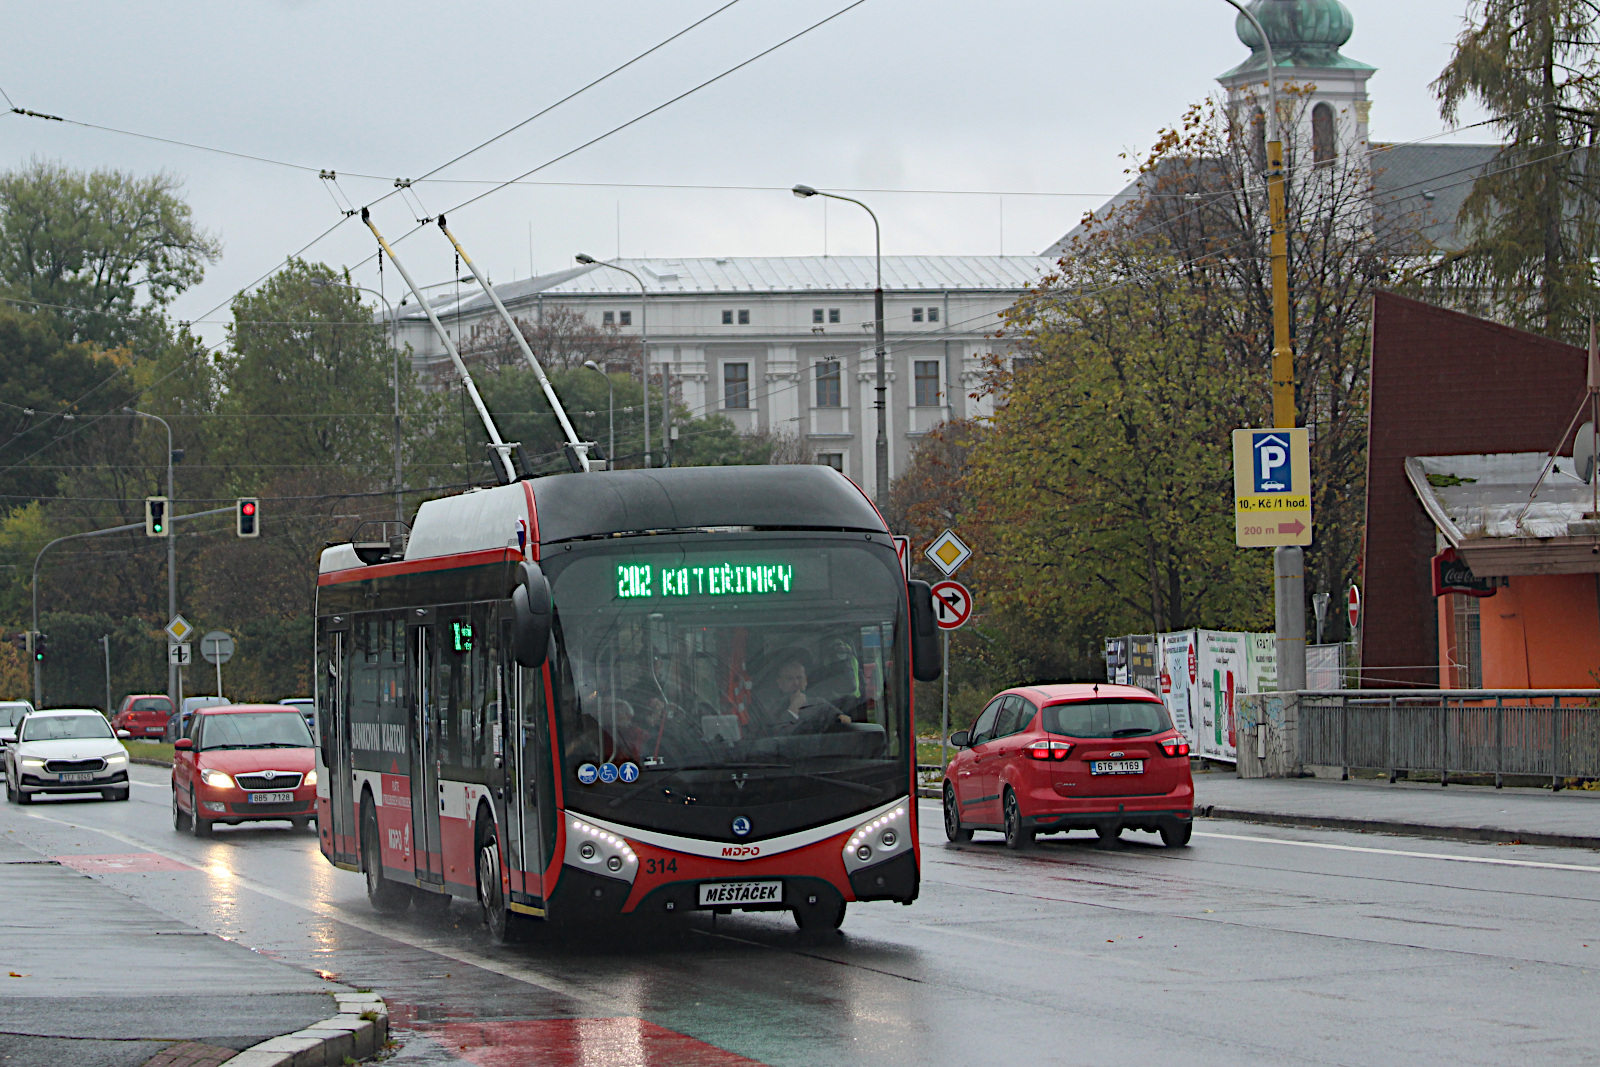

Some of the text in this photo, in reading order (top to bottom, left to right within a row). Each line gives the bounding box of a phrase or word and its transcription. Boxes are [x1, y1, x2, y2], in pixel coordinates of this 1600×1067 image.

[1261, 446, 1286, 480] P
[1239, 499, 1307, 510] 10,- Kč /1 hod.
[1244, 527, 1262, 535] 200
[618, 565, 652, 597] 202
[382, 723, 406, 754] KARTOU
[1097, 761, 1139, 771] 6T6 1169
[272, 793, 290, 801] 7128
[722, 847, 760, 856] MDPO
[646, 858, 678, 874] 314
[706, 883, 778, 902] MĚŠŤÁČEK
